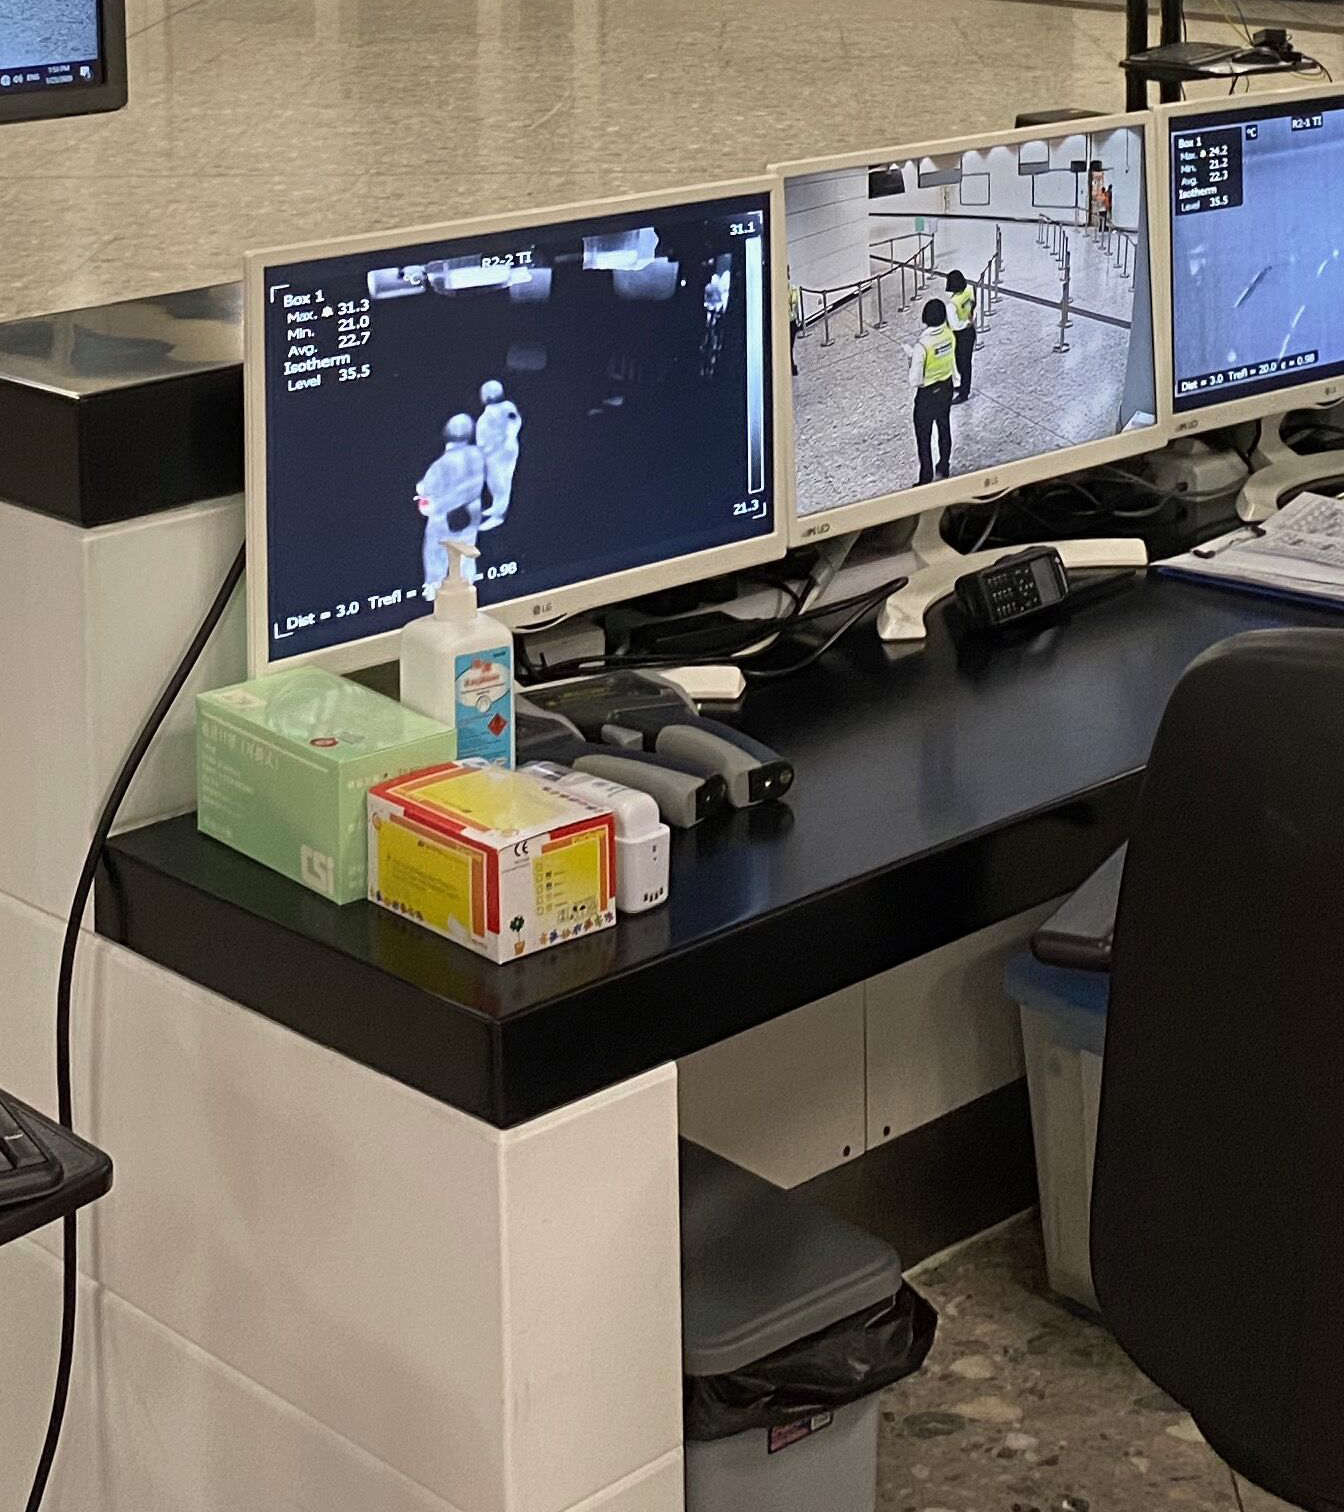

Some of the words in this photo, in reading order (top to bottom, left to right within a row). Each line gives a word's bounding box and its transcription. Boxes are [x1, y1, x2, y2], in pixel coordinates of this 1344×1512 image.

[1178, 137, 1194, 149] Box
[1209, 145, 1228, 158] 24.2
[1209, 157, 1228, 170] 21.2
[1209, 171, 1228, 183] 22.3
[1209, 196, 1229, 208] 35.5
[730, 221, 756, 237] 31.1
[481, 255, 514, 270] R2-2
[283, 293, 311, 308] Box
[314, 289, 325, 304] 1
[287, 310, 318, 324] Max.
[337, 299, 370, 316] 31.3
[287, 327, 315, 341] Min.
[338, 314, 370, 331] 21.0
[287, 345, 318, 359] Avg.
[338, 330, 371, 348] 22.7
[283, 354, 351, 376] Isotherm
[287, 375, 321, 392] Level
[338, 364, 371, 382] 35.5
[1181, 379, 1199, 392] Dist
[1209, 373, 1224, 386] 3.0
[1258, 362, 1277, 375] 20.0
[733, 498, 760, 516] 21.3
[286, 612, 315, 631] Dist
[336, 600, 359, 618] 3.0
[368, 588, 402, 610] Trefl
[487, 561, 517, 580] 0.98
